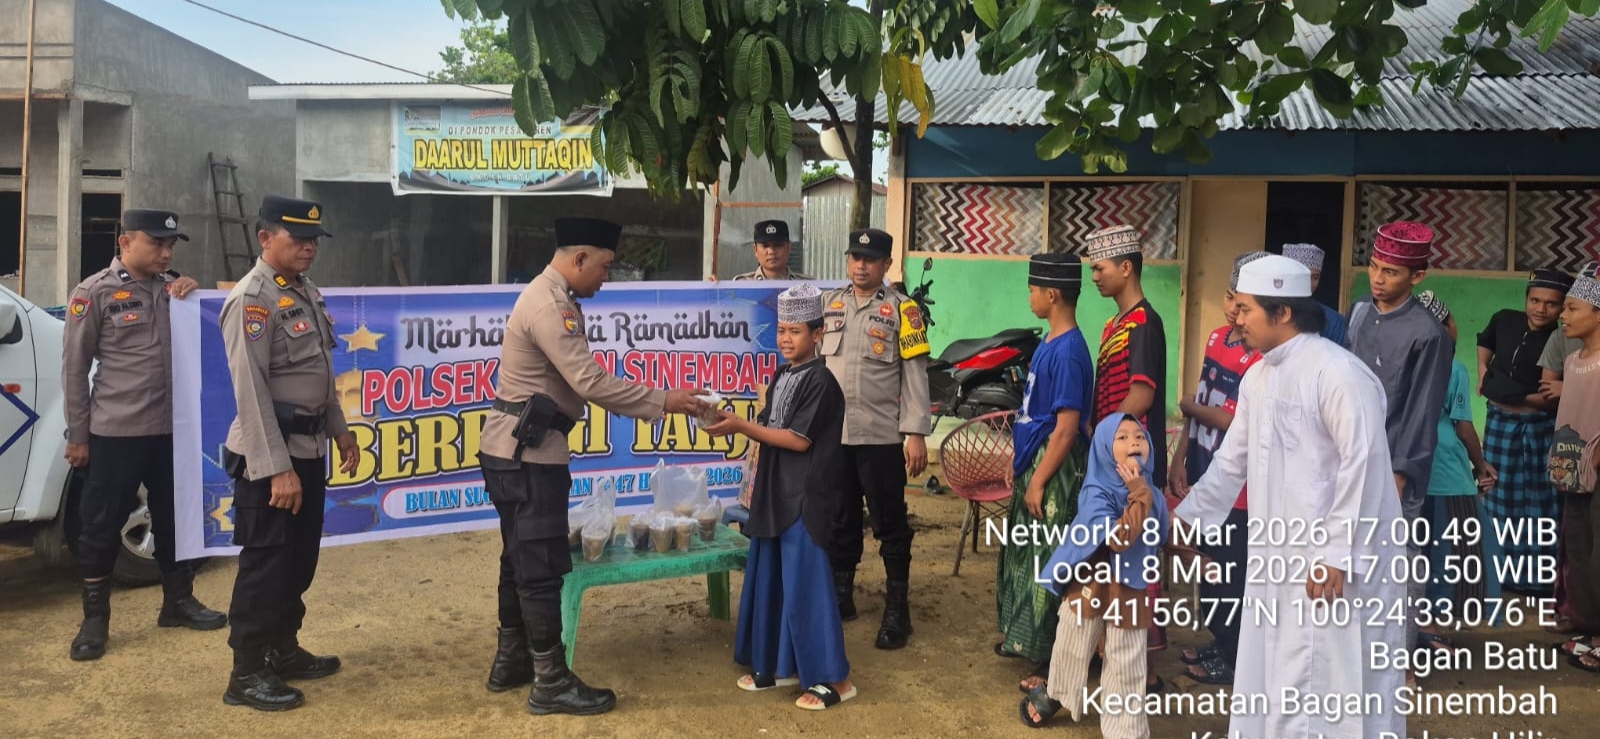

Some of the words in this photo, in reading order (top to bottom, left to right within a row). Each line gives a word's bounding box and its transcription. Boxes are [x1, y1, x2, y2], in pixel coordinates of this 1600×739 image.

[460, 126, 497, 136] PONDOK
[413, 138, 489, 170] DAARUL
[491, 137, 594, 174] MUTTAQIN
[868, 315, 895, 328] POLRI
[361, 357, 499, 416] POLSEK
[622, 351, 778, 394] SINEMBAH
[405, 488, 461, 513] BULAN
[705, 465, 744, 487] 2026
